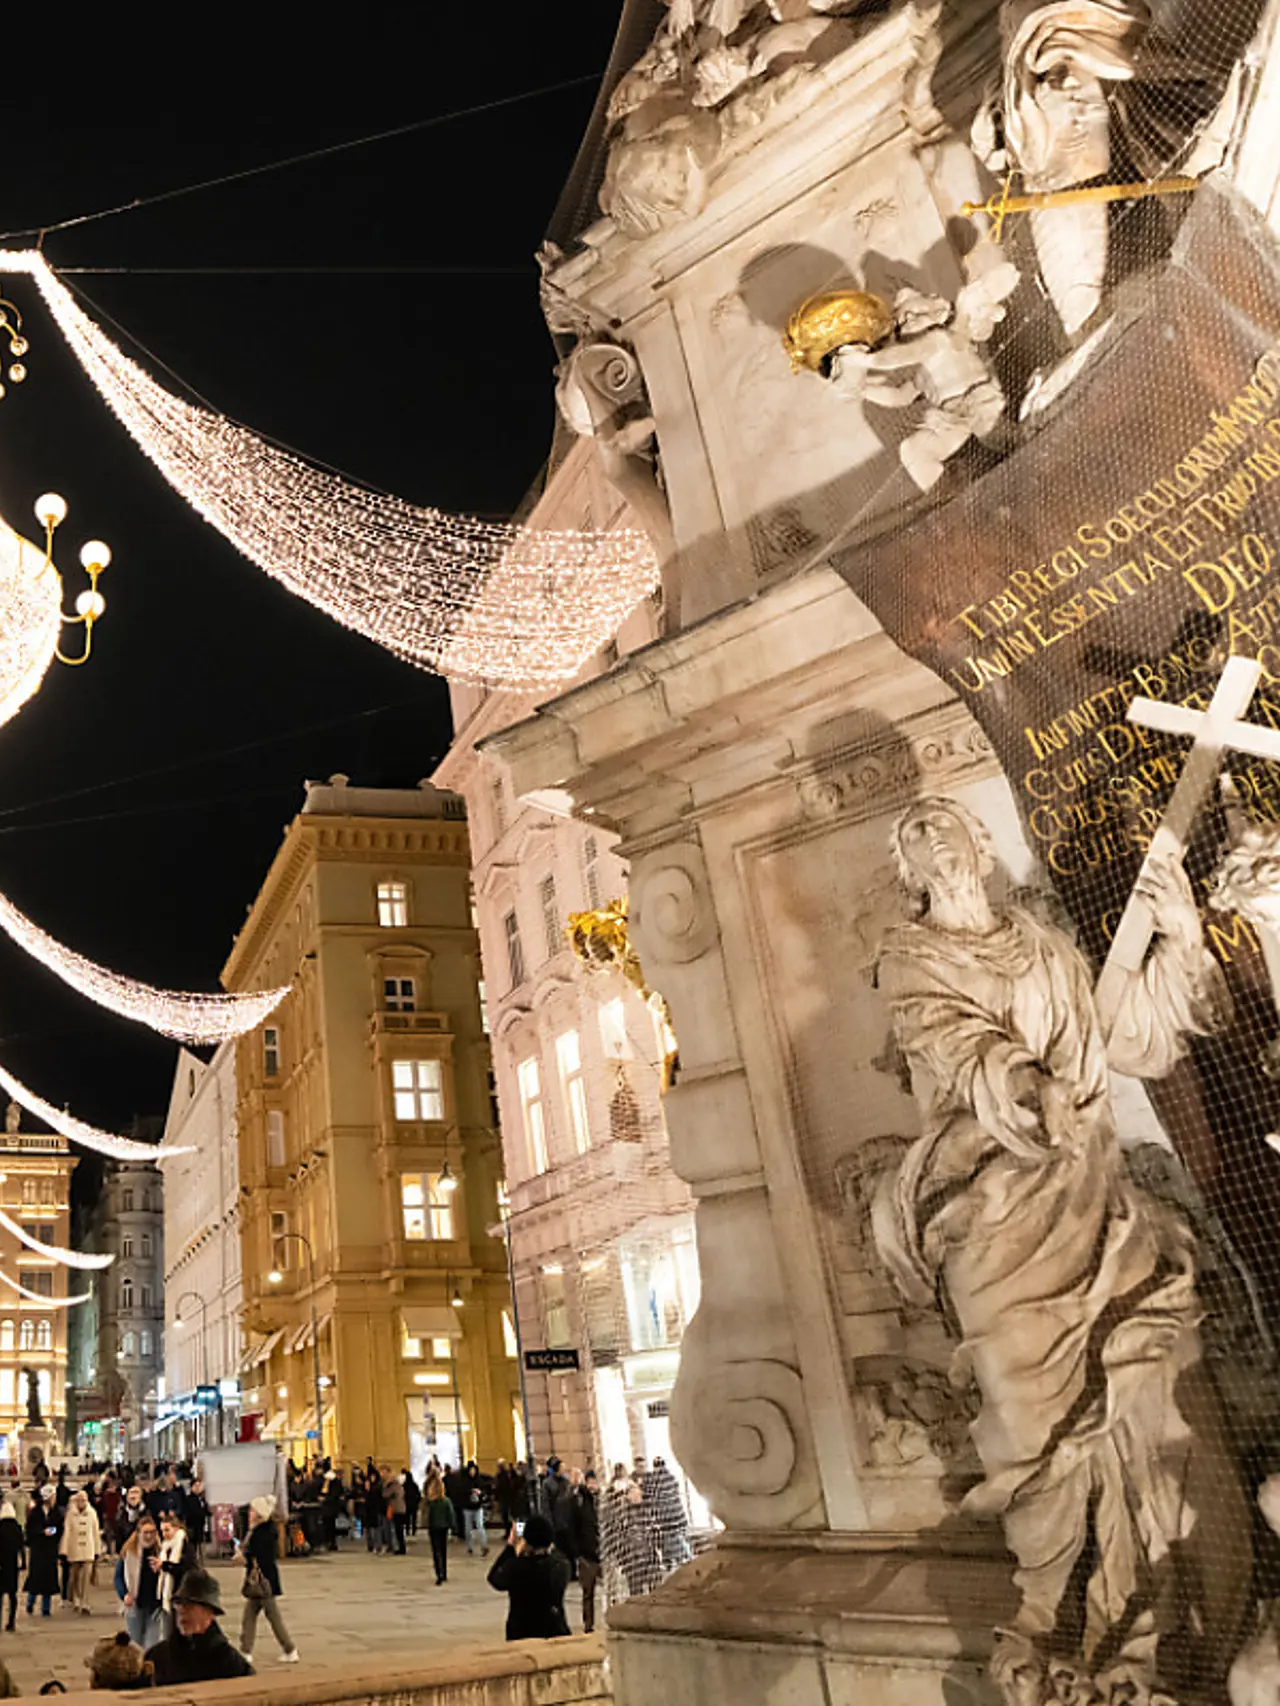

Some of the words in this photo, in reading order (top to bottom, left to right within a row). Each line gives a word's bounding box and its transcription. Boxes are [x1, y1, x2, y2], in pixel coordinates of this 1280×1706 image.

[948, 590, 1026, 640] TIBI
[1010, 546, 1089, 603] REGI
[1024, 552, 1172, 646] ESSENTIA
[1152, 519, 1204, 562] ET
